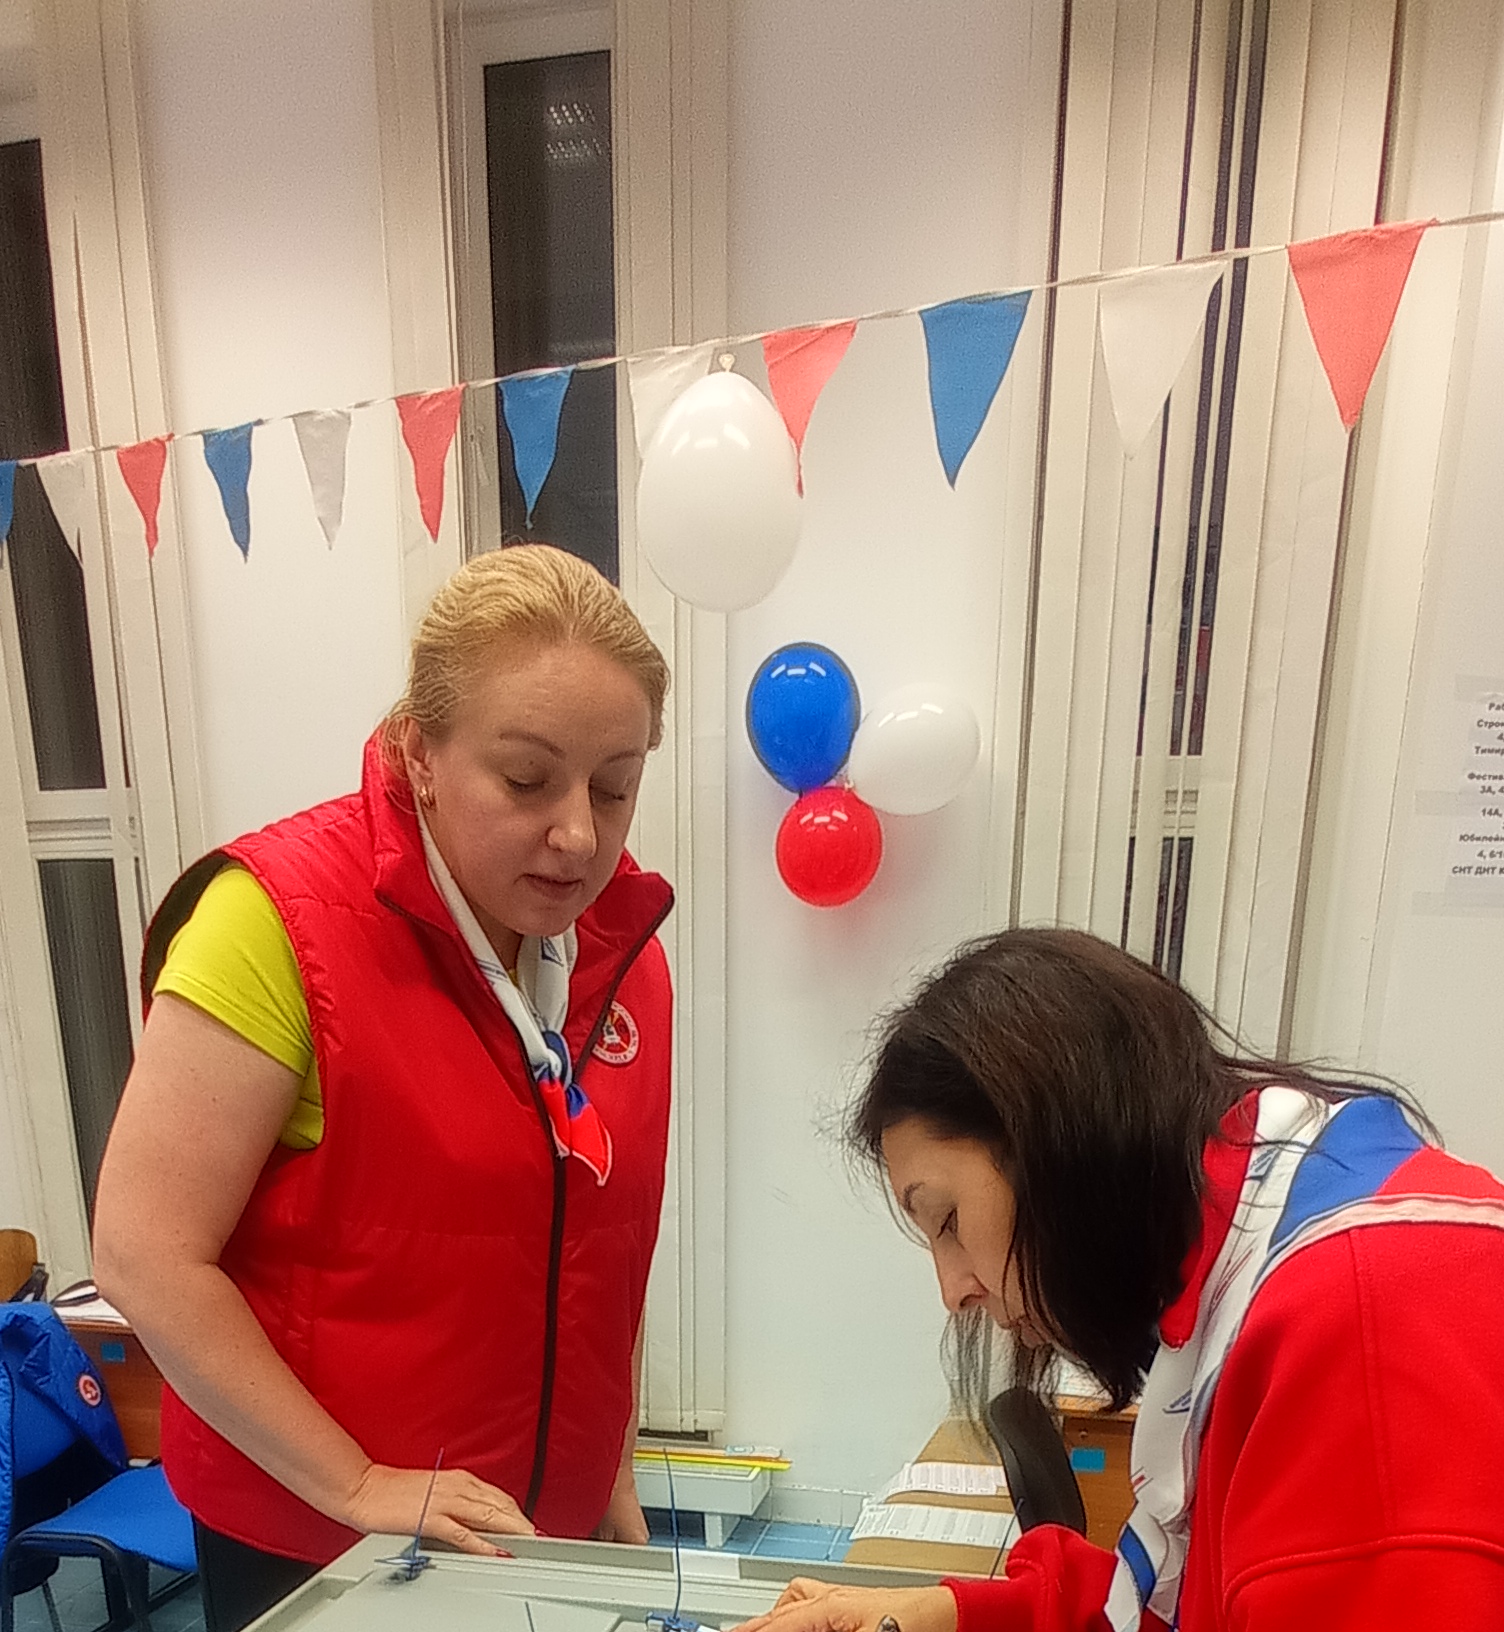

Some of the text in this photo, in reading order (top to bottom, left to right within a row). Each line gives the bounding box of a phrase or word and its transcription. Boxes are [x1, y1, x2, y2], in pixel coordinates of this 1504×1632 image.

[1467, 772, 1504, 781] Фестив
[1452, 865, 1474, 875] СНТ
[1474, 866, 1497, 876] ДНТ
